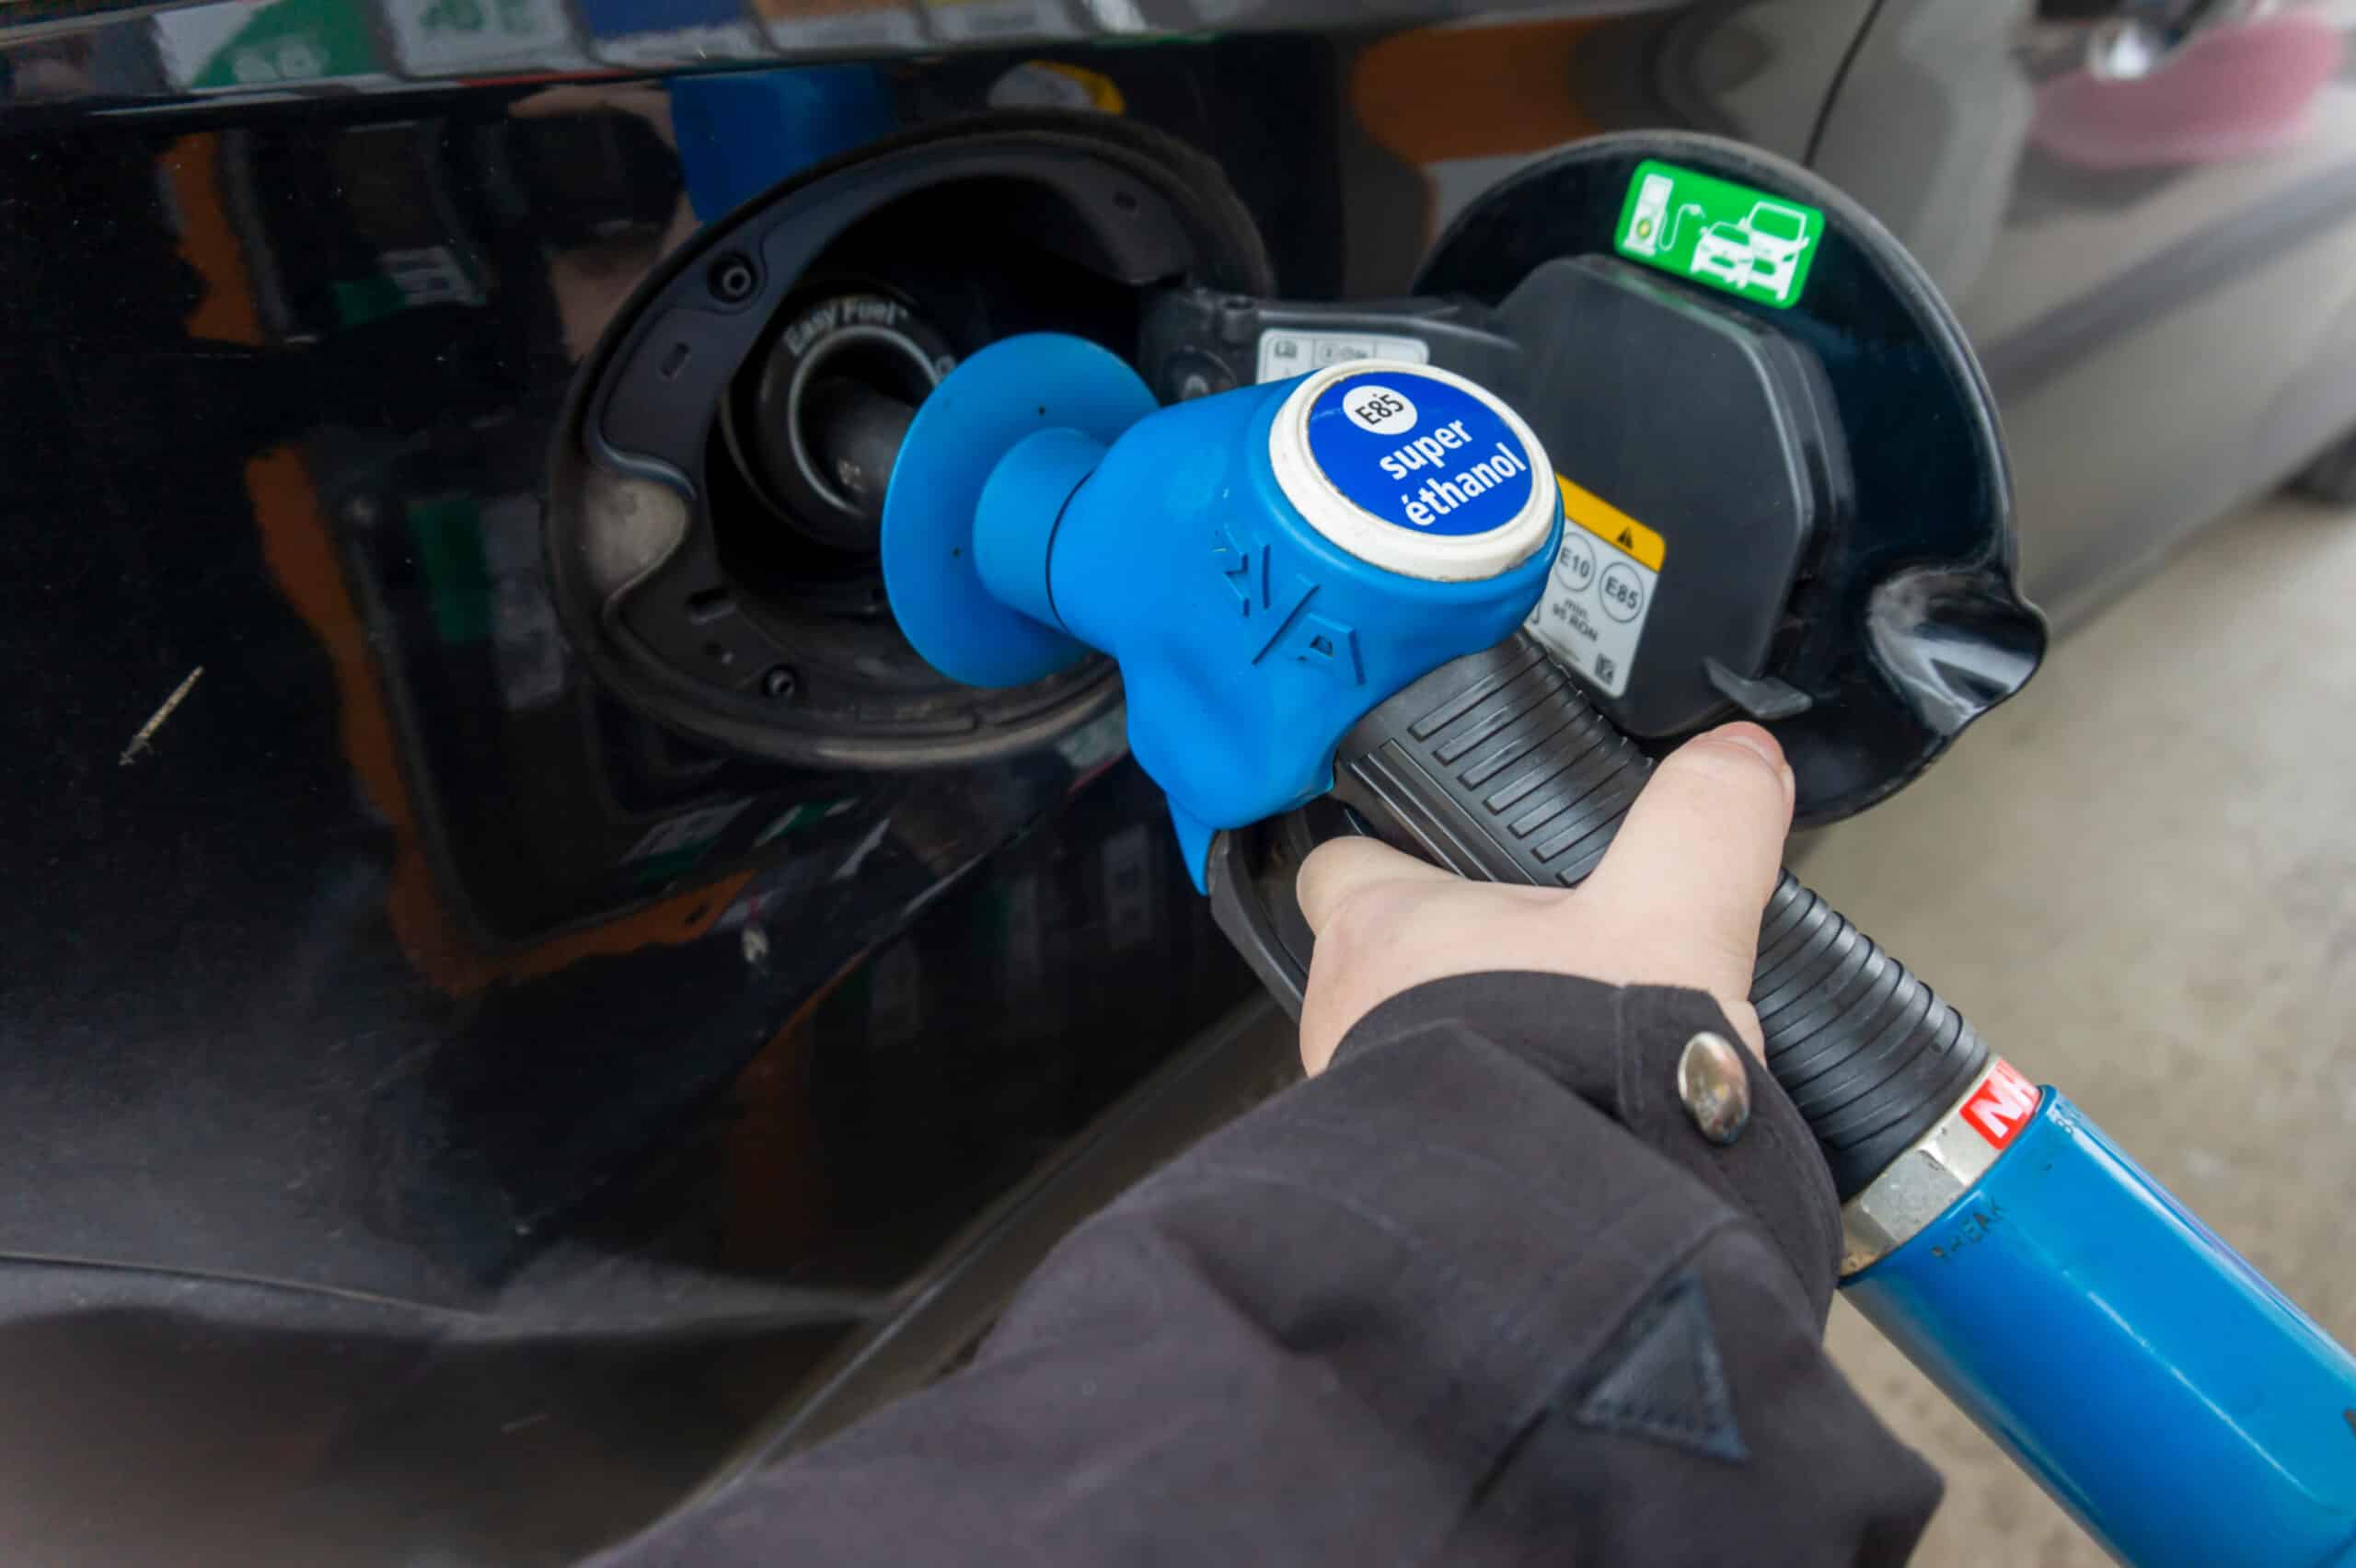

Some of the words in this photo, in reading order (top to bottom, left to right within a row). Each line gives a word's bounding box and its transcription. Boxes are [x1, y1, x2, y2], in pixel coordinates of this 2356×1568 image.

[1355, 393, 1405, 426] E85
[1380, 420, 1472, 481] super
[1401, 442, 1528, 527] éthanol
[1559, 547, 1590, 579] E10
[1605, 576, 1638, 610] E85
